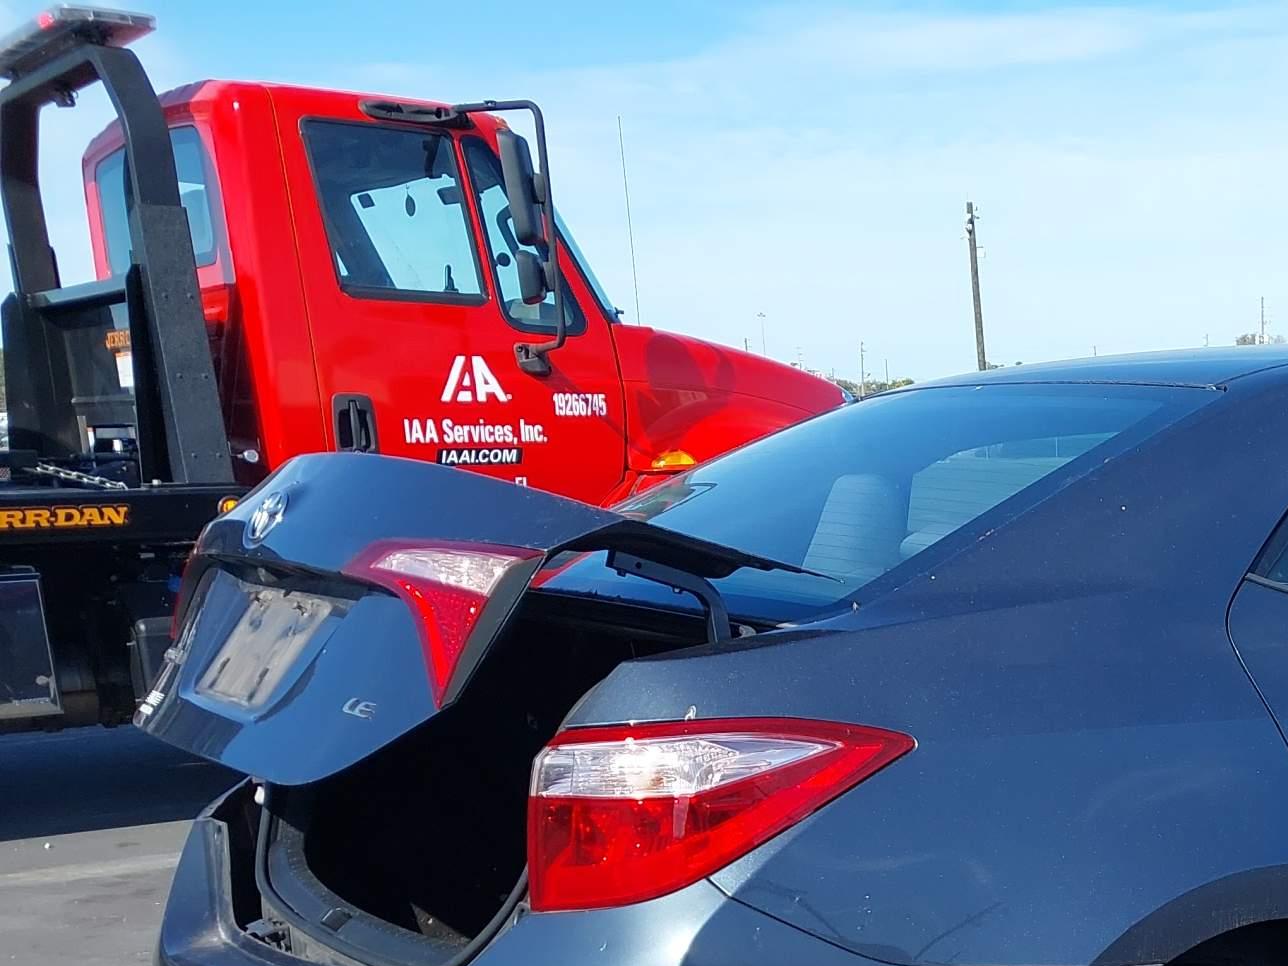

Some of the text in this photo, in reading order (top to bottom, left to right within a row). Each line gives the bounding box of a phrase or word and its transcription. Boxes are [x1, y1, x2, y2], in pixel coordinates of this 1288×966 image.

[552, 392, 607, 416] 19266745
[404, 419, 547, 444] IAA Services, Inc.
[442, 449, 517, 464] IAAI.COM
[342, 697, 377, 719] LE
